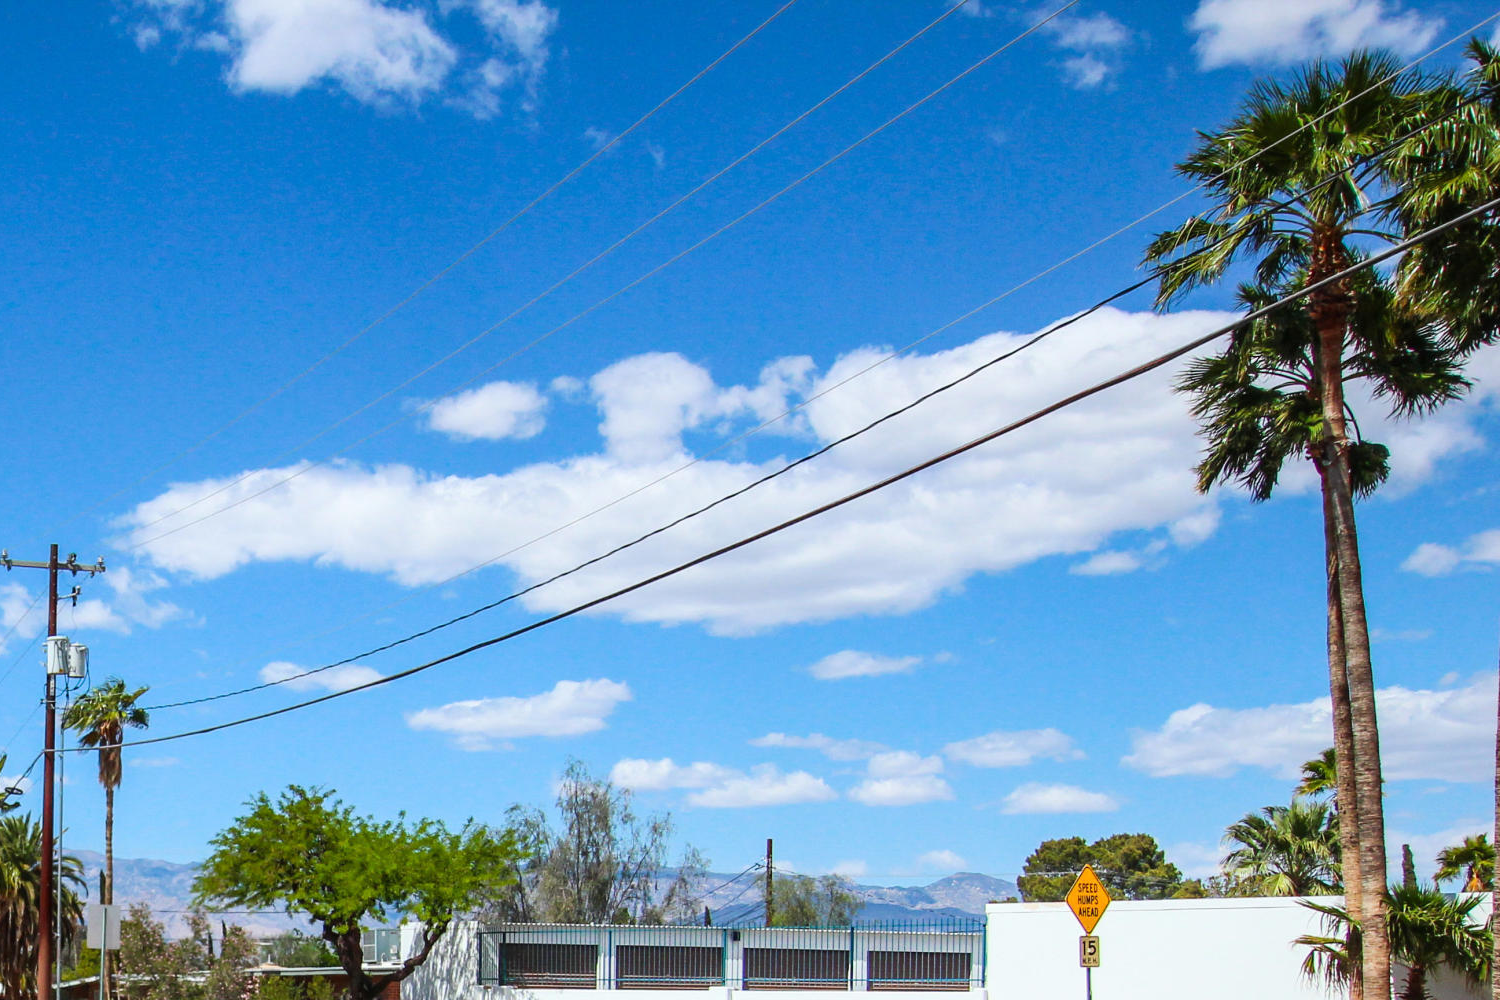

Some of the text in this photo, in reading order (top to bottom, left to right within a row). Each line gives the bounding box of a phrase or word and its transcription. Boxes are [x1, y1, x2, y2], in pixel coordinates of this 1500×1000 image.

[1078, 883, 1097, 893] SPEED
[1078, 895, 1098, 905] HUMPS
[1078, 907, 1099, 917] AHEAD
[1082, 940, 1097, 956] 15
